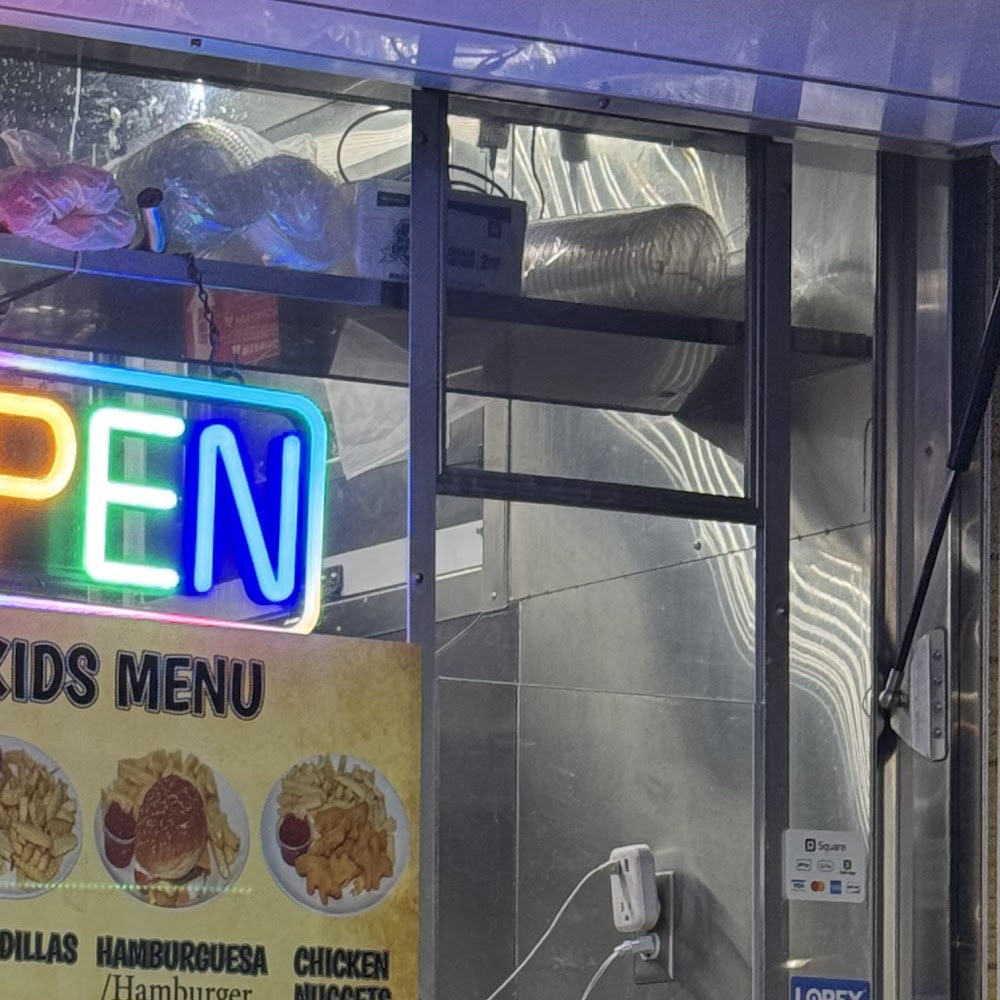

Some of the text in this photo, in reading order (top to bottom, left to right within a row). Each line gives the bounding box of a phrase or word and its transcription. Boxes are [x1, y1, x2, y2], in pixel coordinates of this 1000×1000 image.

[116, 648, 266, 721] MENU
[818, 840, 847, 853] Square
[96, 934, 269, 977] HAMBURGUESA
[293, 946, 390, 981] CHICKEN
